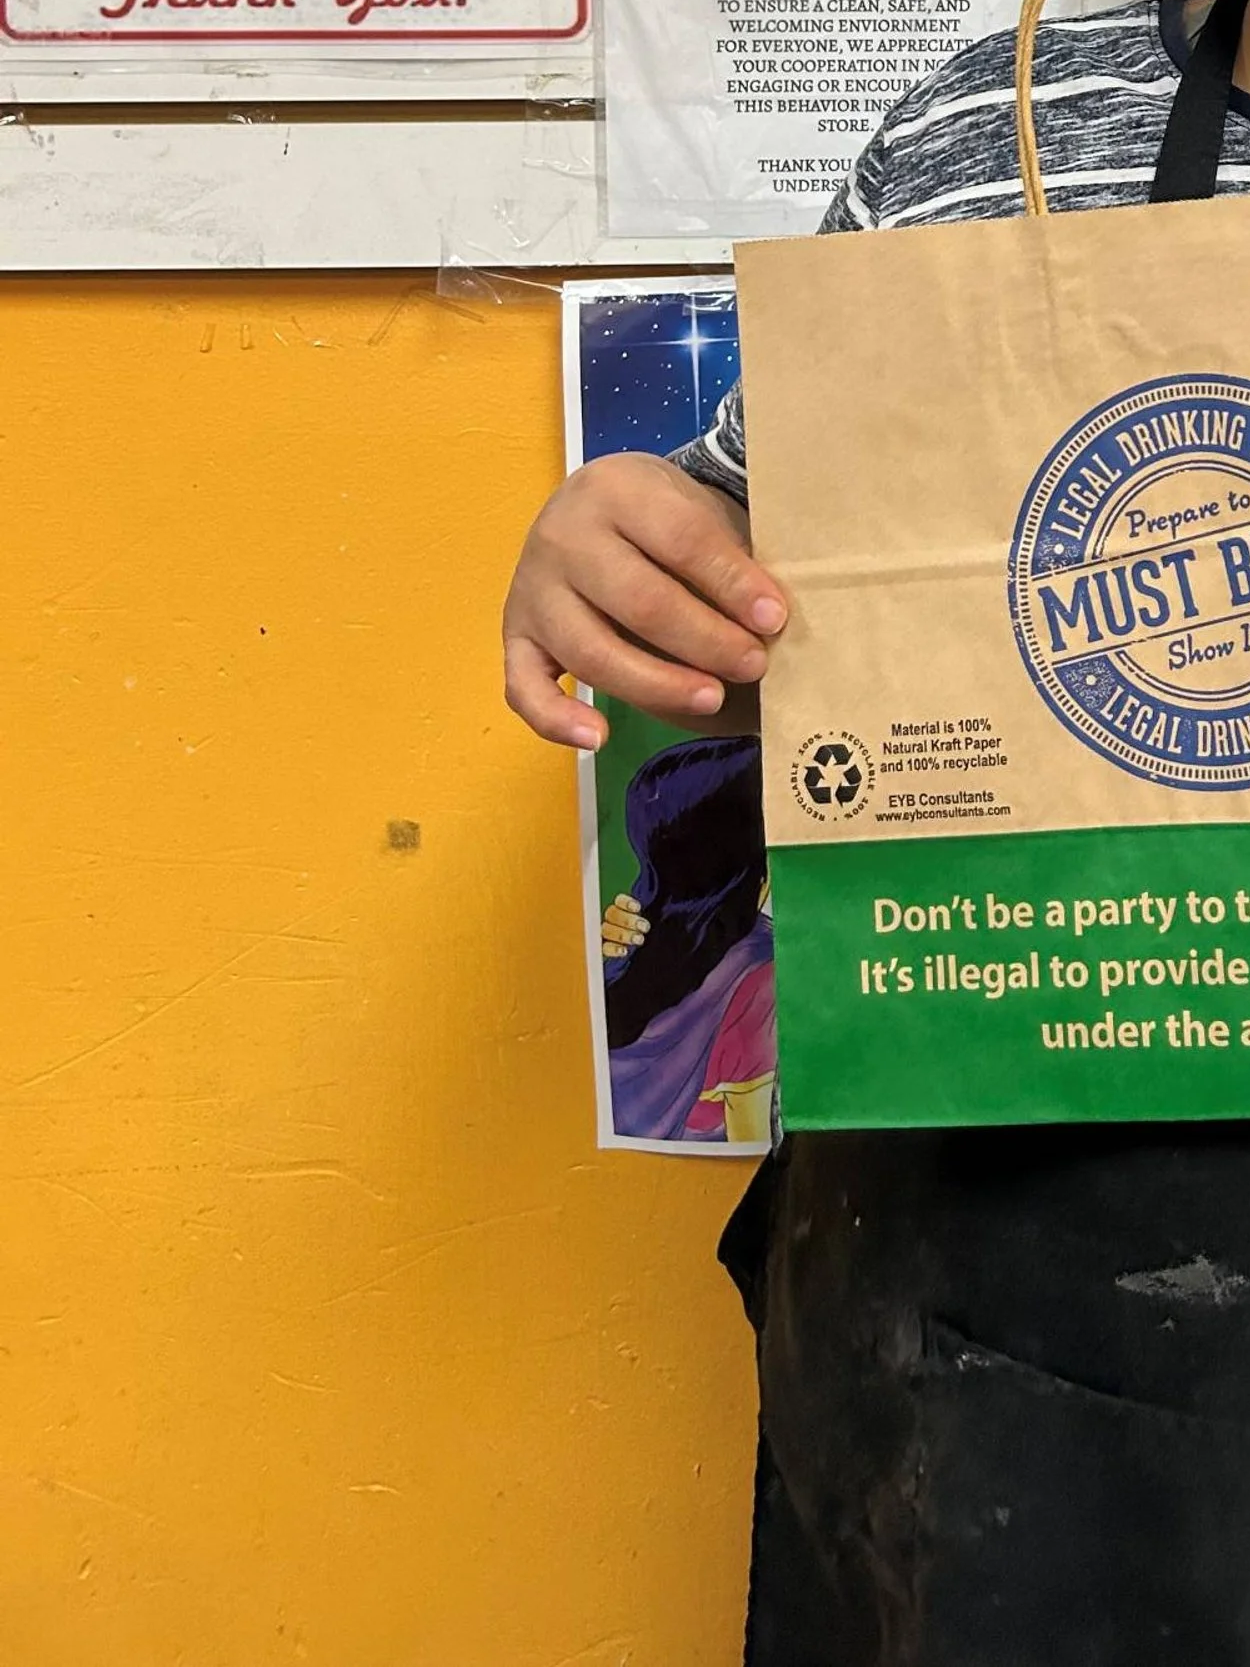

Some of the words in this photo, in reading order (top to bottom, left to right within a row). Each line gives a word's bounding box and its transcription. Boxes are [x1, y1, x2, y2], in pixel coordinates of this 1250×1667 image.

[728, 20, 833, 33] WELCOMING
[839, 19, 960, 32] ENVIORNMENT
[1050, 453, 1121, 541] LEGAL
[1115, 410, 1247, 466] DRINKING
[1126, 501, 1220, 540] Prepare
[1228, 491, 1250, 511] to
[1037, 549, 1198, 652] MUST
[1169, 635, 1233, 670] Show
[892, 721, 939, 736] Material
[944, 721, 954, 734] is
[958, 718, 991, 733] 100%
[1101, 685, 1183, 754] LEGAL
[880, 758, 903, 773] and
[907, 758, 940, 771] 100%
[943, 753, 1008, 770] recyclable
[883, 740, 928, 755] Natural
[931, 738, 961, 752] Kraft
[965, 737, 1001, 752] Paper
[889, 794, 915, 807] EYB
[919, 790, 994, 805] Consultants
[987, 894, 1033, 928] be
[1046, 901, 1065, 926] a
[1074, 892, 1176, 935] party
[1186, 891, 1225, 923] to
[925, 952, 1039, 999] illegal
[1050, 956, 1088, 988] to
[1100, 948, 1249, 996] provide
[1042, 1012, 1156, 1048] under
[1165, 1010, 1229, 1047] the
